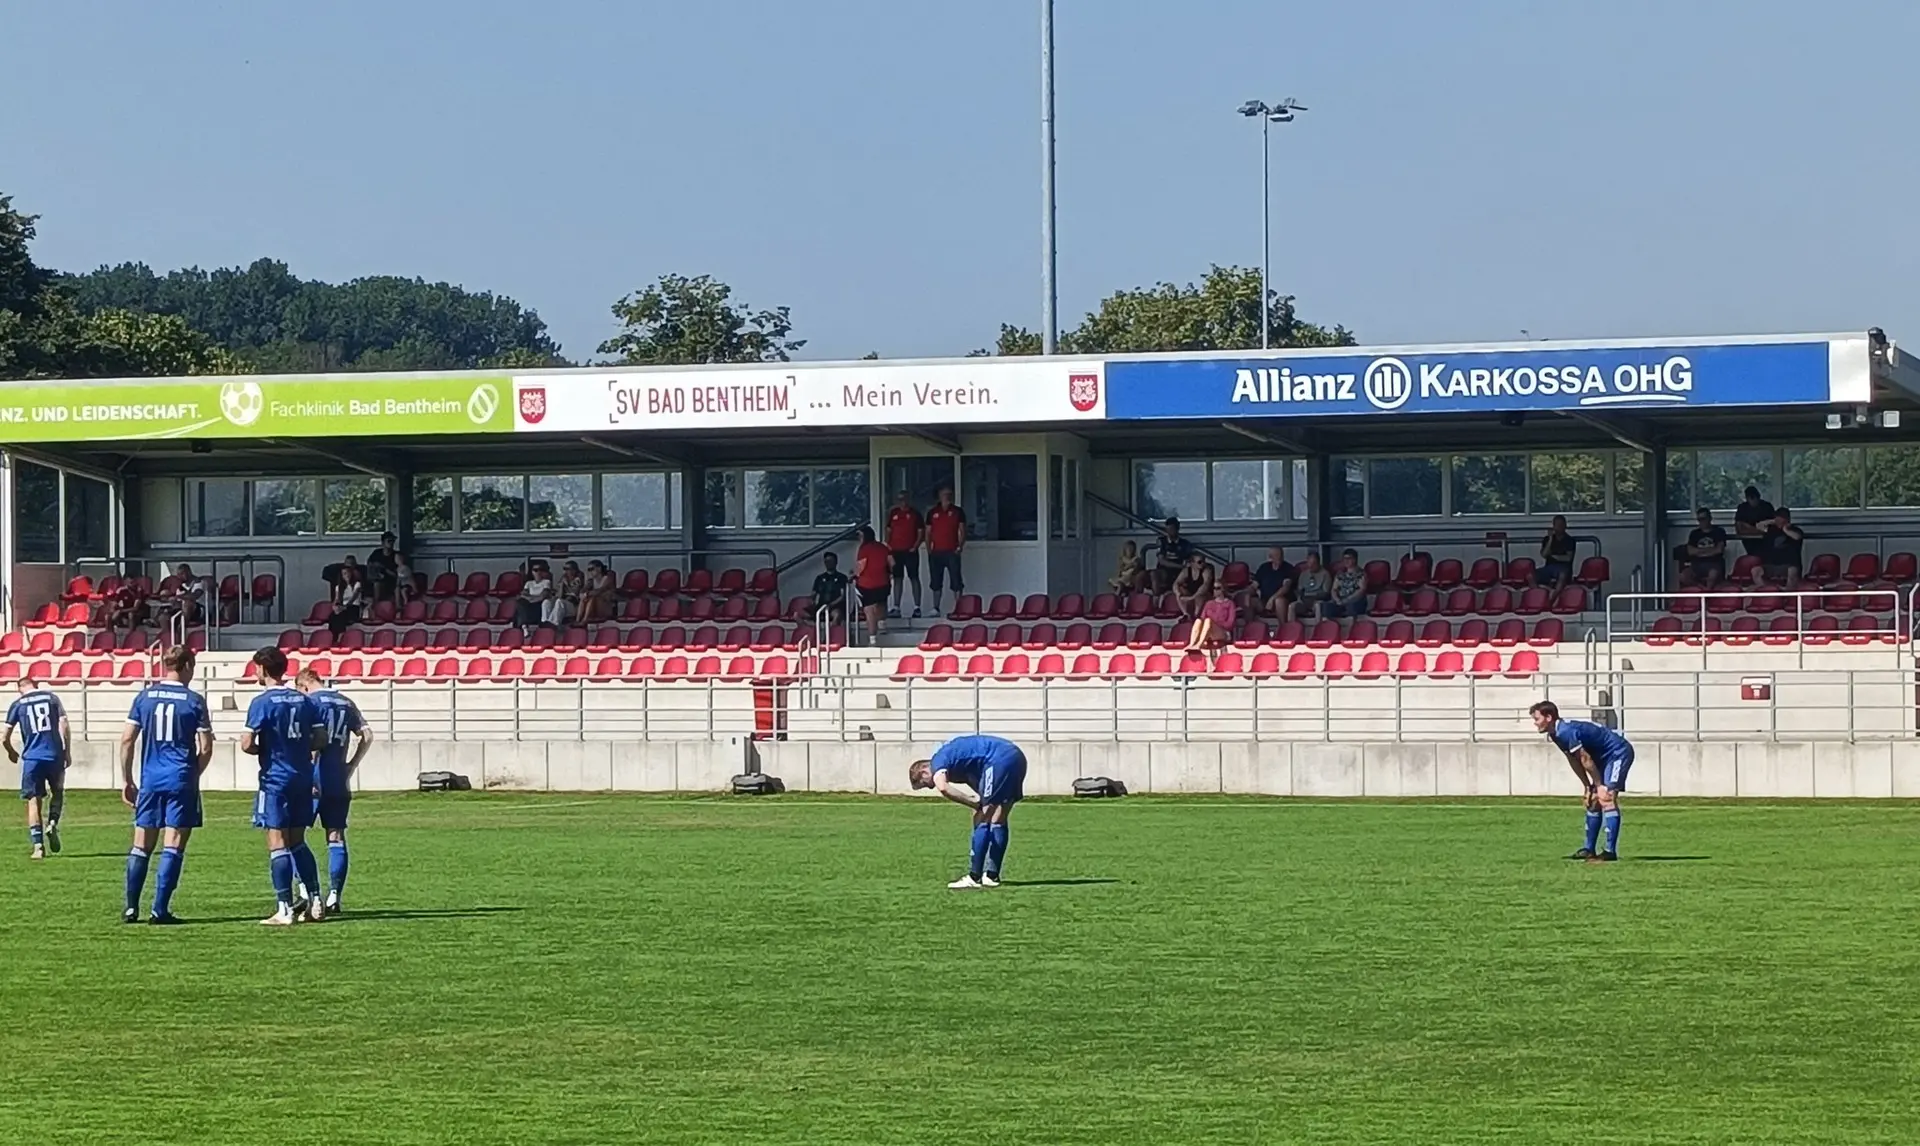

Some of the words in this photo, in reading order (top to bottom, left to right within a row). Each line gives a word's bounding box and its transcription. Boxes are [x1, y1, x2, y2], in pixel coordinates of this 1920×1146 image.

[1231, 367, 1356, 404] Allianz
[1420, 363, 1607, 398] KARKOSSA
[1613, 356, 1693, 394] OHG
[0, 406, 29, 423] NZ.
[32, 406, 68, 422] UND
[72, 403, 202, 422] LEIDENSCHAFT.
[270, 399, 345, 417] Fachklinik
[349, 399, 381, 417] Bad
[384, 397, 462, 416] Bentheim
[616, 389, 641, 414] SV
[649, 387, 685, 414] BAD
[692, 385, 789, 413] BENTHEIM
[843, 384, 902, 407] Mein
[913, 381, 999, 405] Verein.
[26, 702, 52, 735] 18
[154, 702, 176, 742] 11
[326, 707, 349, 746] 14
